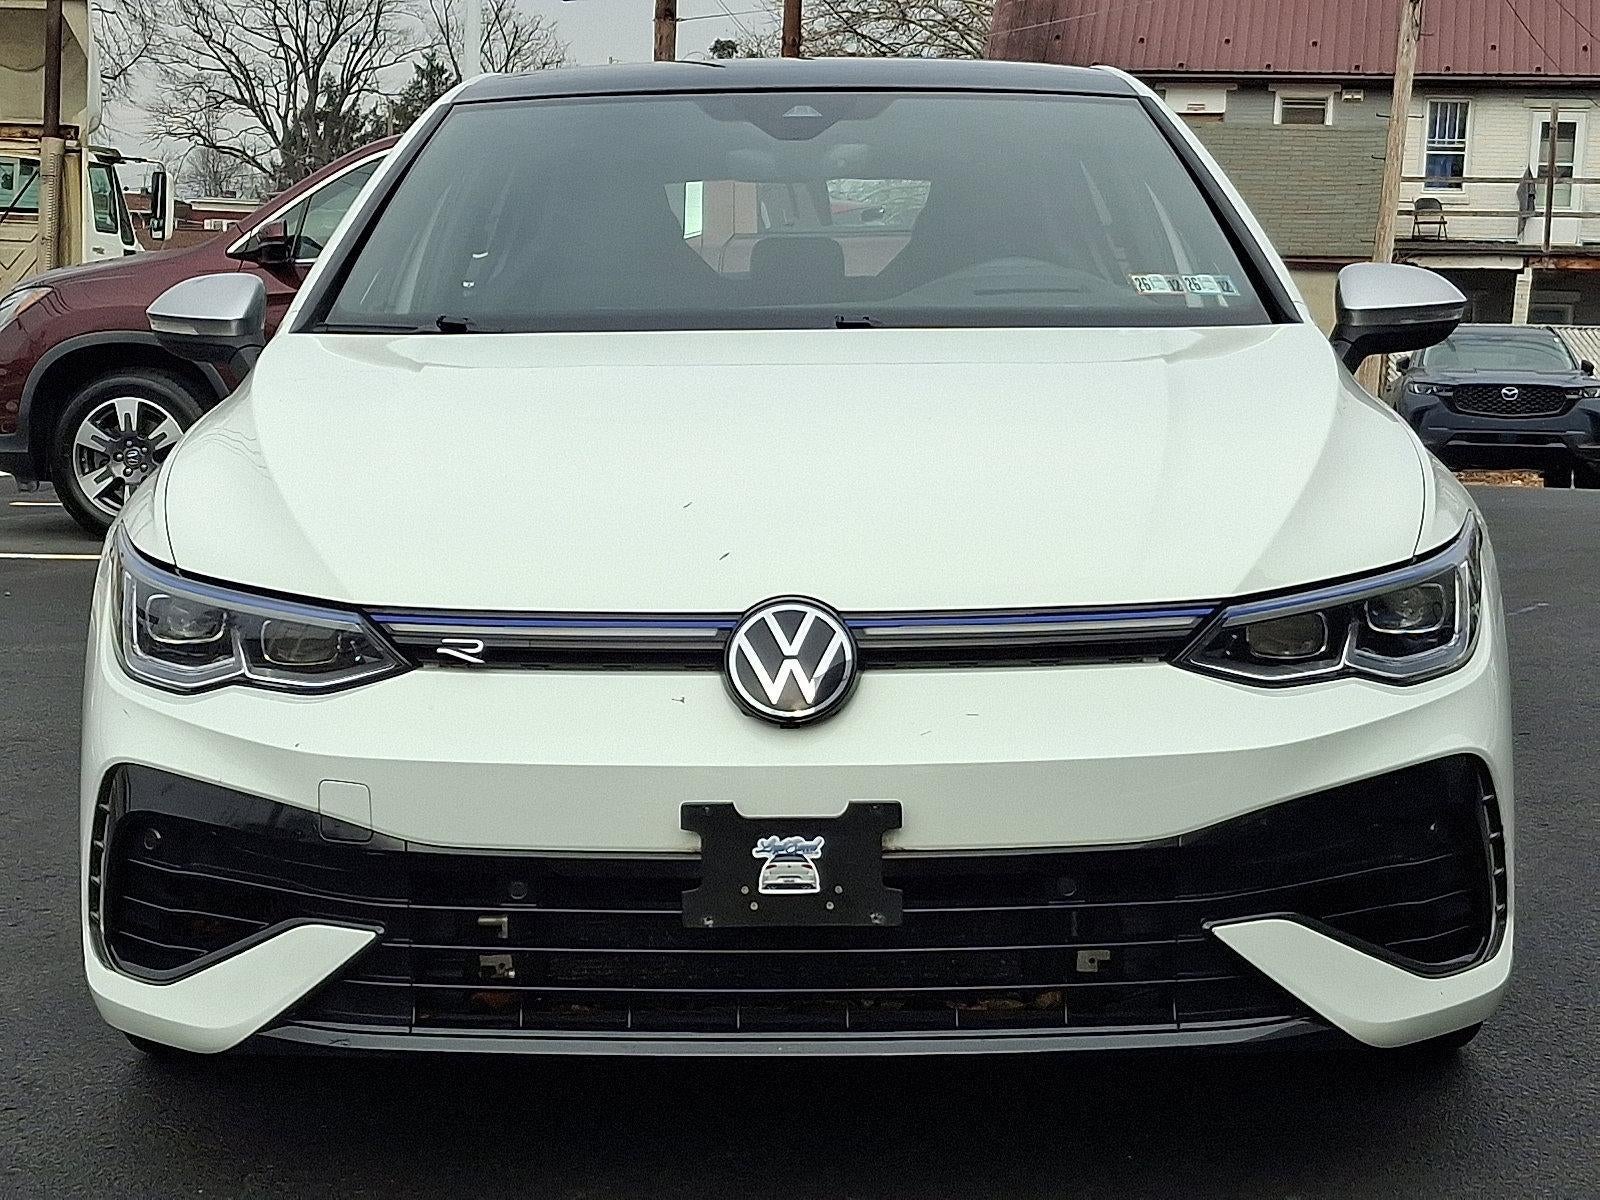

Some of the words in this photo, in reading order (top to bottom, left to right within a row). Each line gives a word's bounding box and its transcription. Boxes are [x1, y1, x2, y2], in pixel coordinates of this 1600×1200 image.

[1134, 277, 1152, 292] 26
[1167, 279, 1184, 292] 12
[1184, 277, 1202, 292] 26
[436, 638, 486, 664] R
[732, 605, 848, 709] VW
